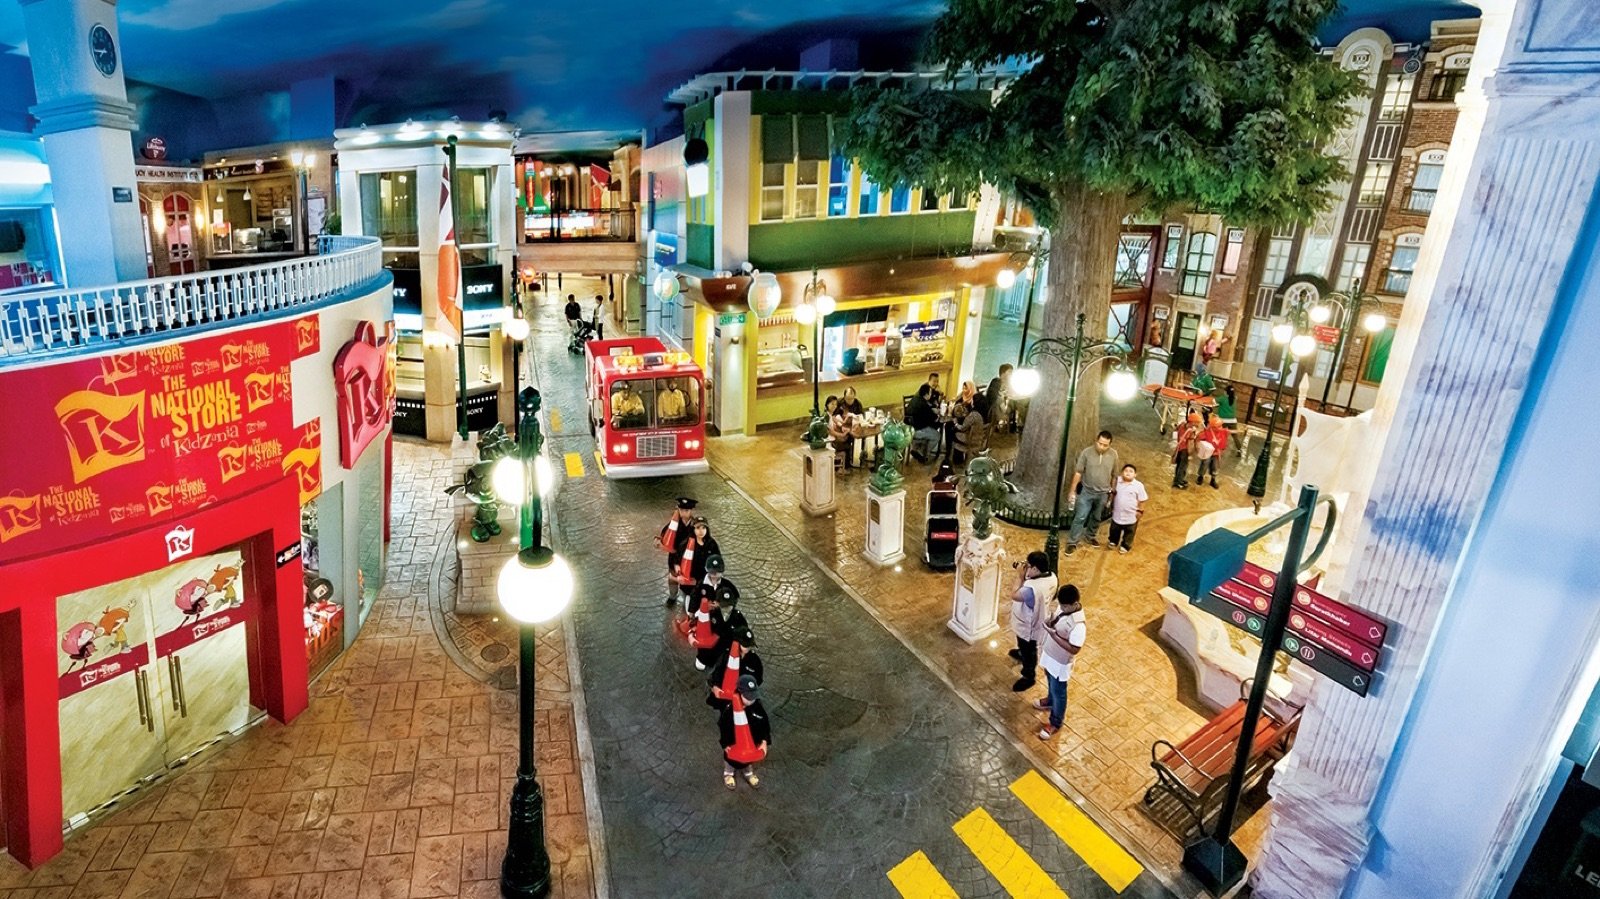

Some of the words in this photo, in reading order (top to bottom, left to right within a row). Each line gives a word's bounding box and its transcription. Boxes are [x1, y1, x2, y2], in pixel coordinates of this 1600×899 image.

[466, 283, 494, 295] SONY
[162, 374, 187, 393] THE
[151, 379, 235, 418] NATIONAL
[171, 395, 242, 438] STORE
[160, 434, 170, 449] of
[173, 425, 239, 458] KidZania
[43, 486, 95, 508] NATIONAL
[48, 485, 64, 495] THE
[56, 494, 101, 517] STORE
